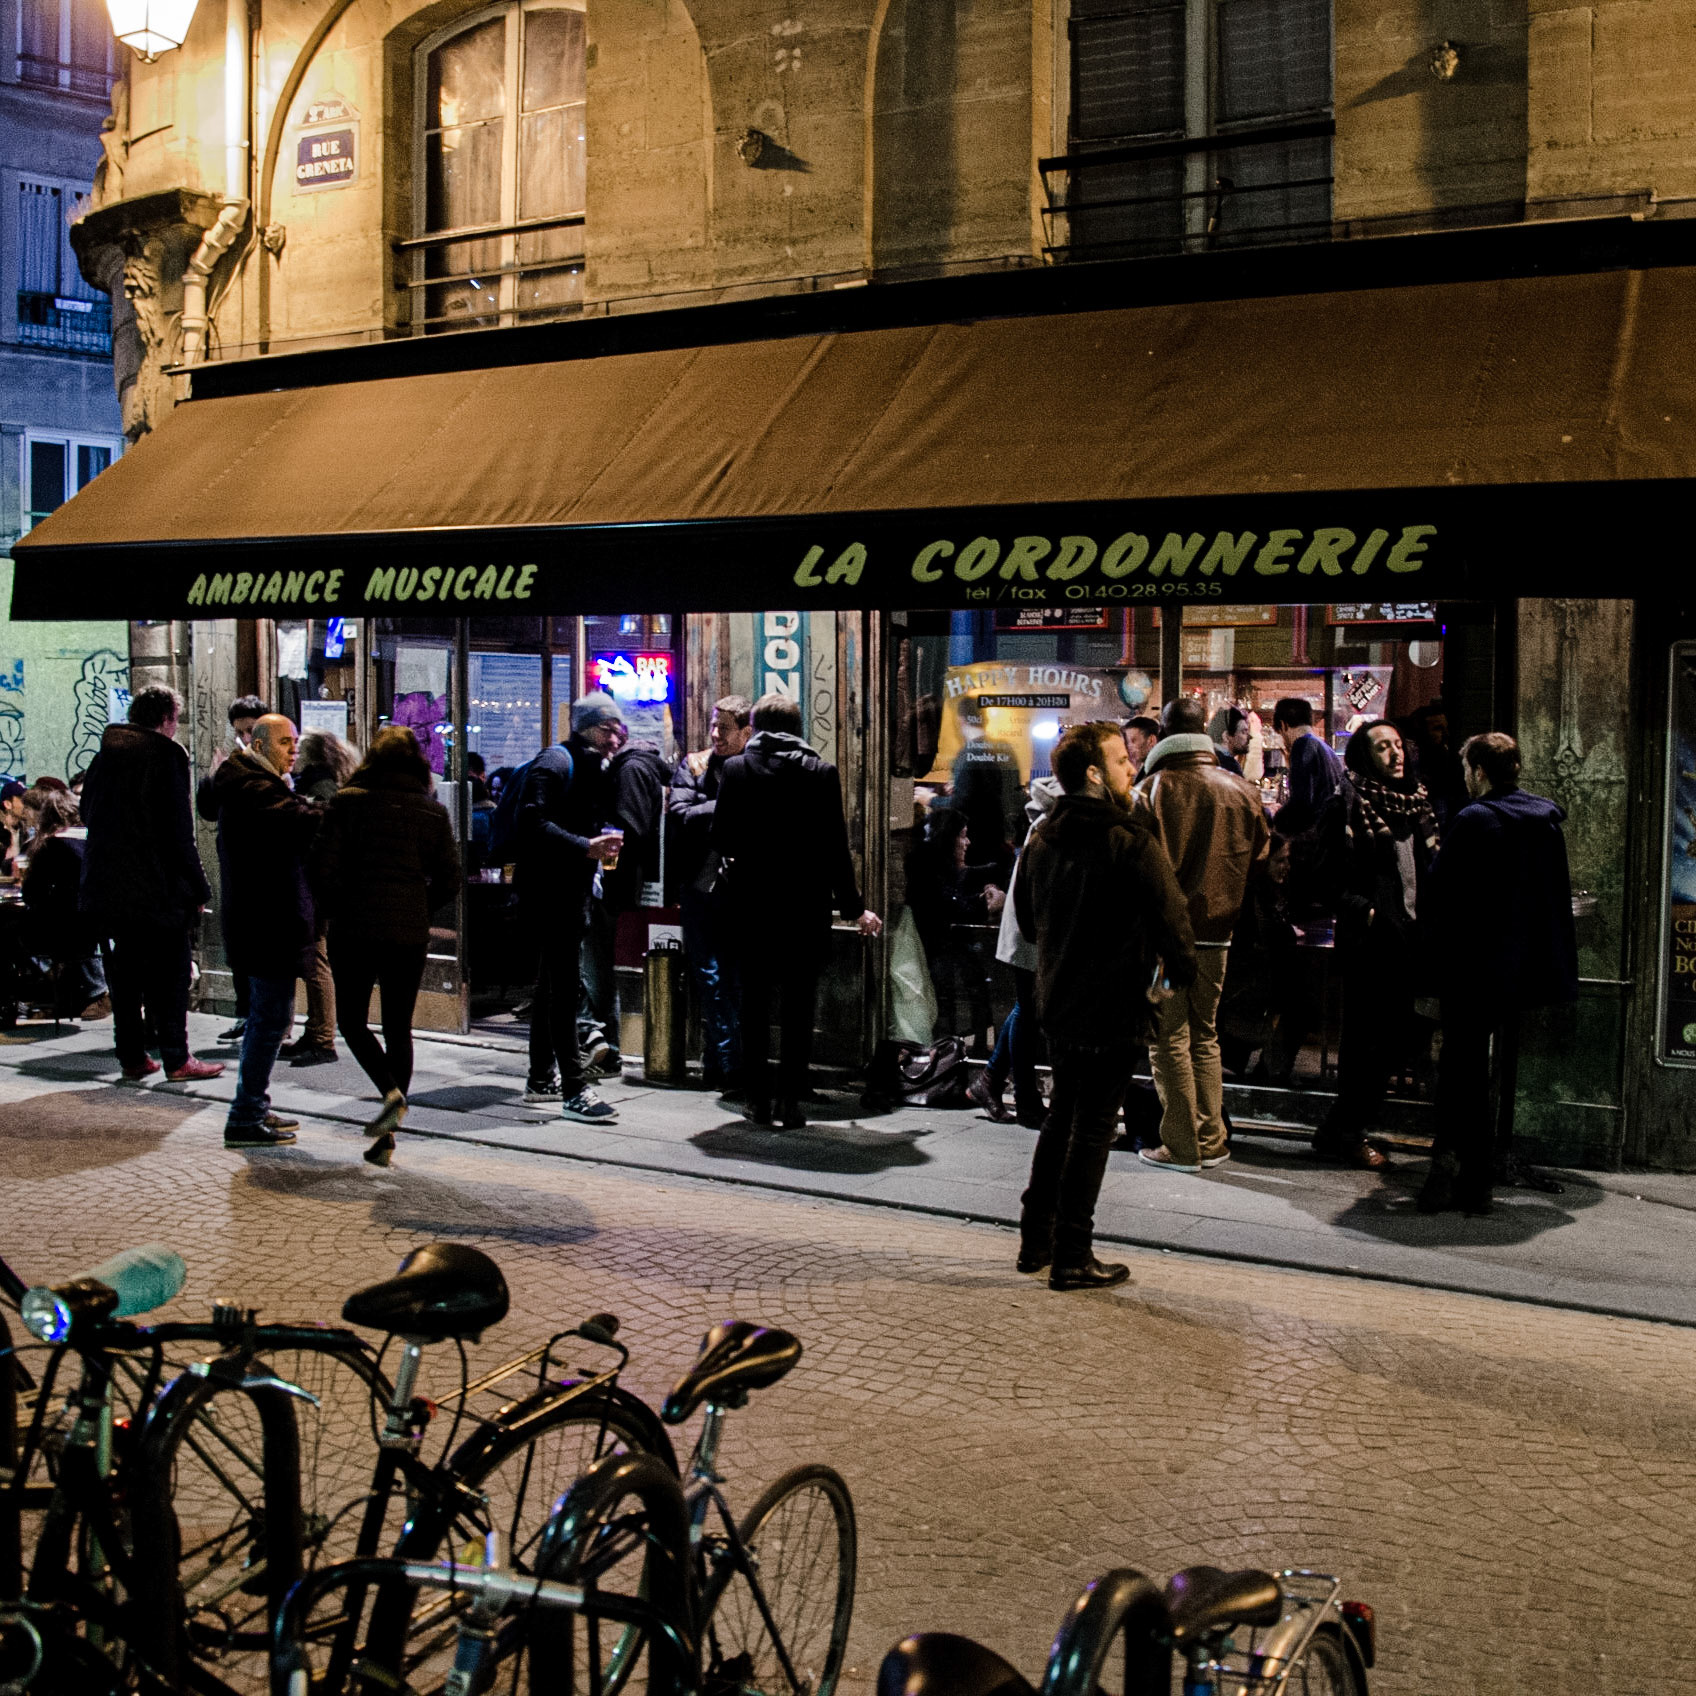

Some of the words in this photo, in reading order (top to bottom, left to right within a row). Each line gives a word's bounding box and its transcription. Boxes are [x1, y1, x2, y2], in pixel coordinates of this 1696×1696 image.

[311, 140, 340, 158] RUE
[297, 157, 354, 179] GRENETA
[793, 541, 868, 587] LA
[911, 524, 1438, 586] CORDONNERIE
[186, 568, 345, 606] AMBIANCE
[364, 563, 539, 601] MUSICALE
[1011, 585, 1047, 600] fax
[636, 656, 668, 675] BAR
[946, 666, 1018, 698] HAPPY
[1028, 666, 1103, 698] HOURS
[980, 696, 995, 706] De
[997, 696, 1027, 706] 17H00
